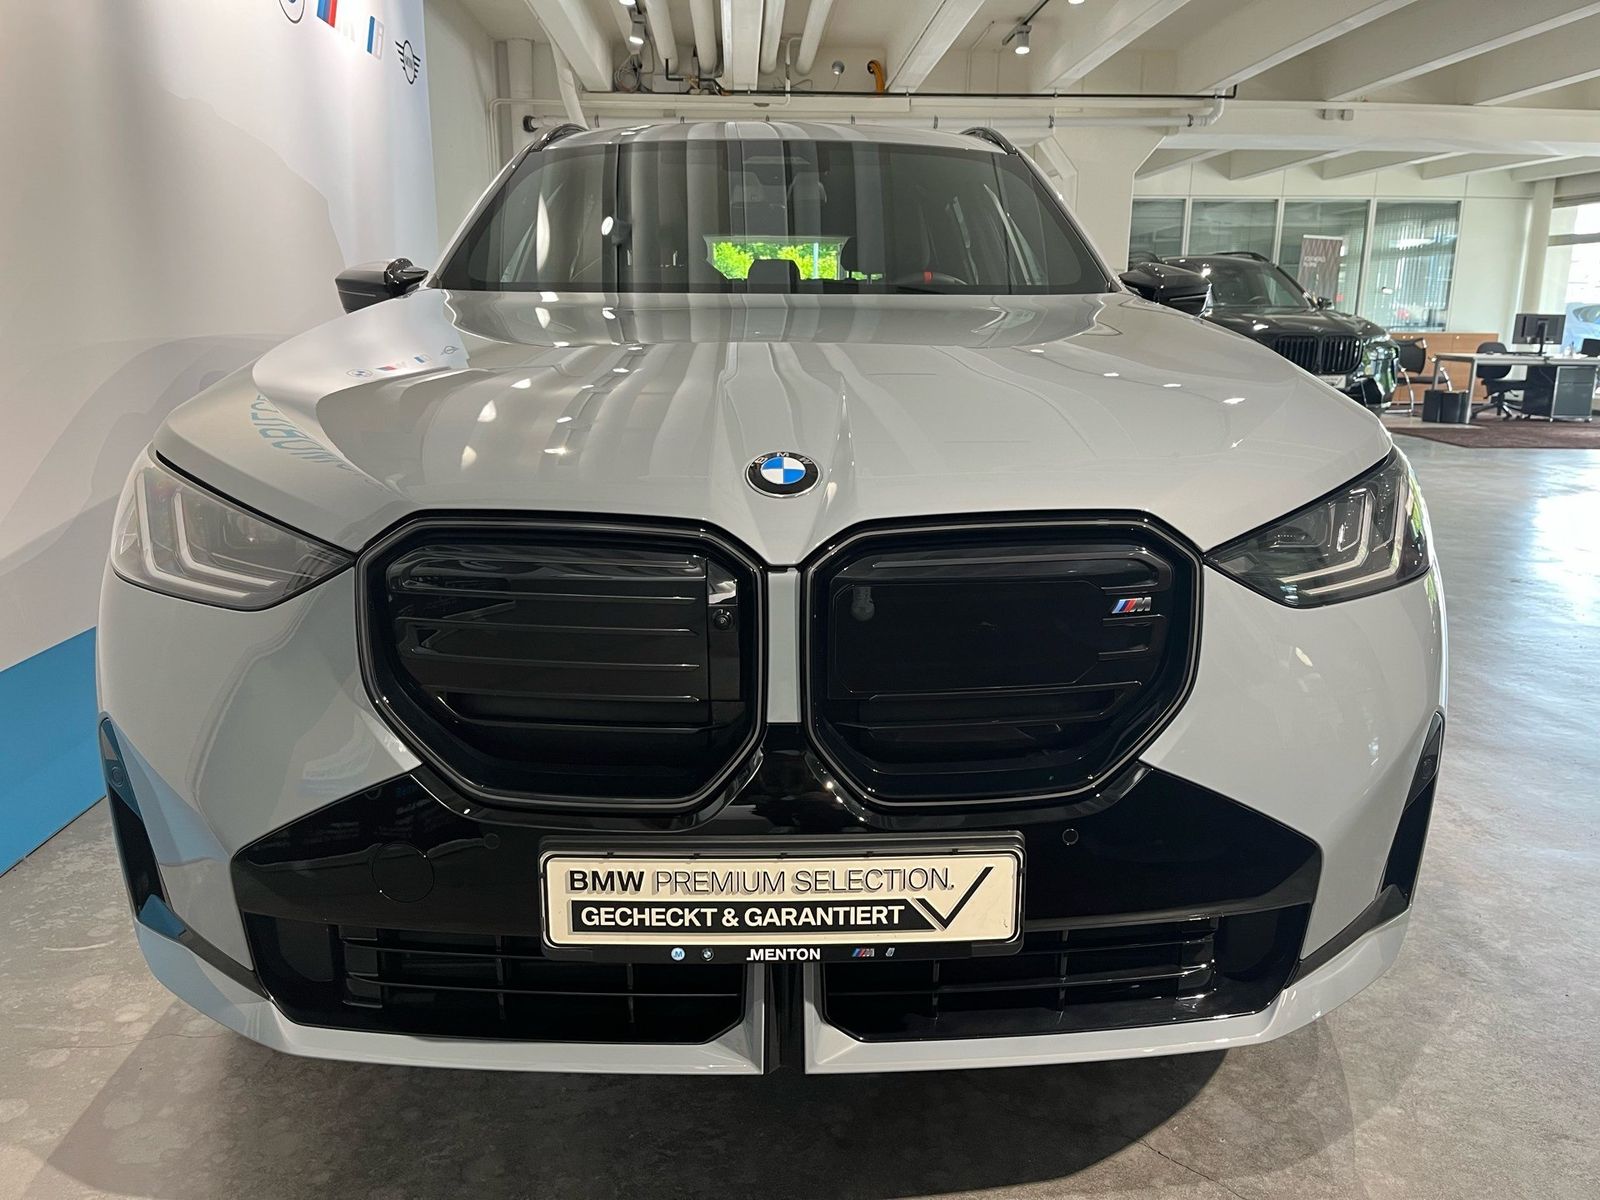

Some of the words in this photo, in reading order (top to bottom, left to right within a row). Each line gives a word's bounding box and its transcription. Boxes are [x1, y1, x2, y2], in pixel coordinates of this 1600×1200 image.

[568, 870, 645, 892] BMW
[656, 870, 786, 893] PREMIUM
[794, 867, 955, 892] SELECTION.
[581, 906, 718, 927] GECHECKT
[721, 907, 740, 927] &
[743, 905, 905, 927] GARANTIERT
[747, 948, 821, 961] MENTON
